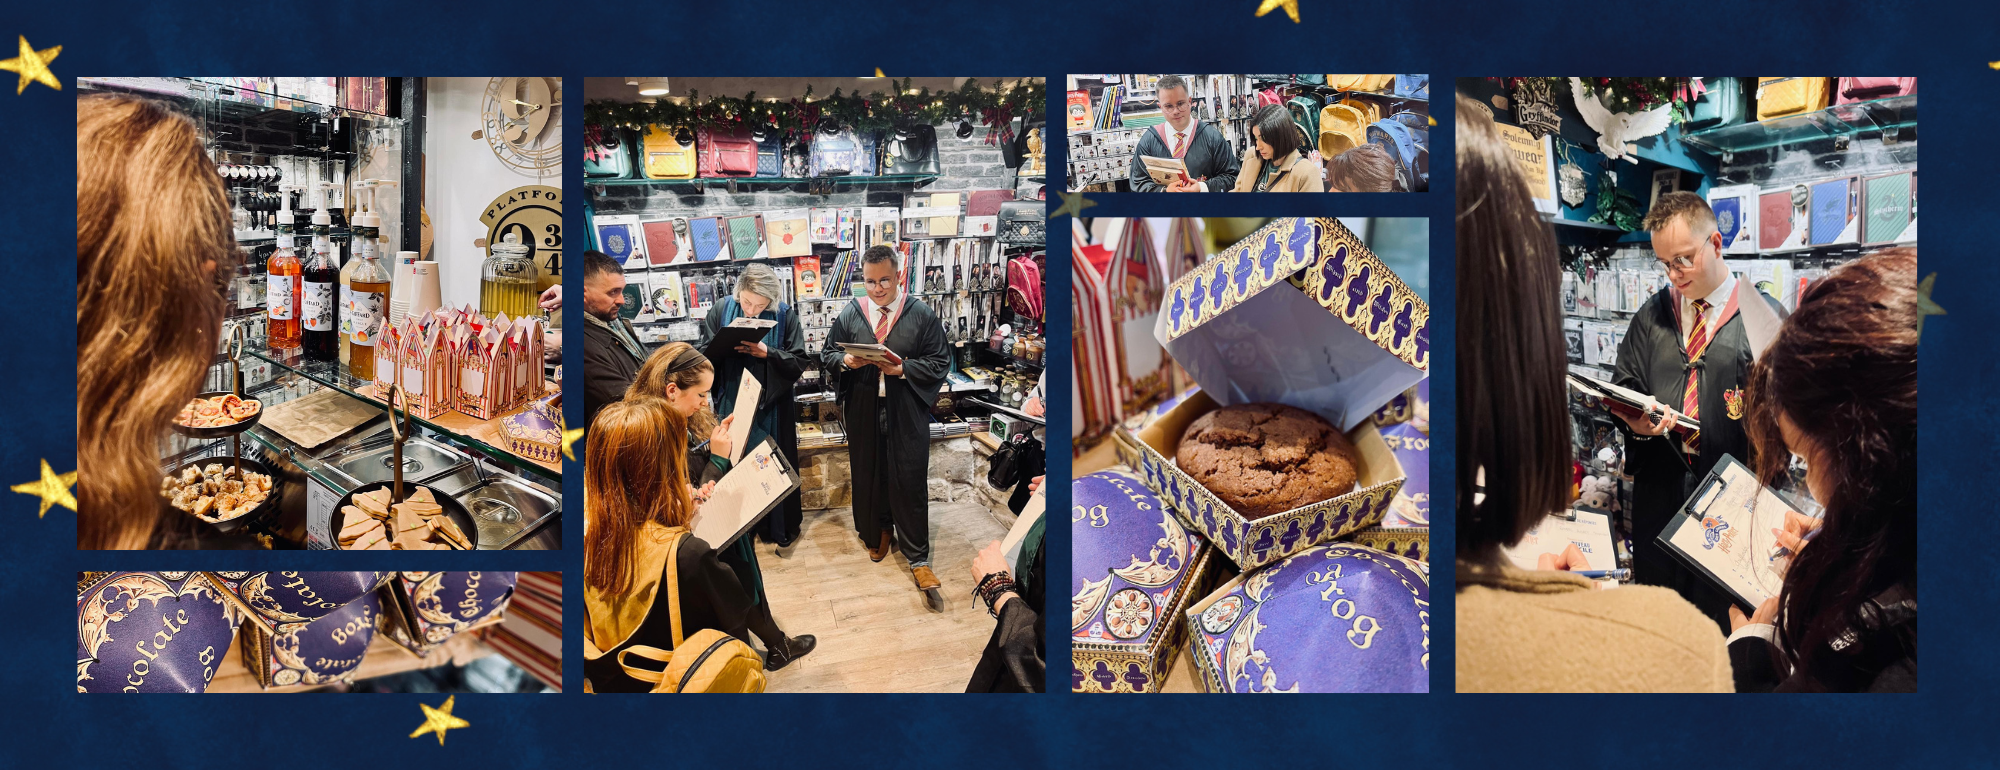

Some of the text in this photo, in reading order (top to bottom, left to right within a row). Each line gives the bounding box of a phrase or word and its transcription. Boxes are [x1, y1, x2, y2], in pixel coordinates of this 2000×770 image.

[1520, 105, 1559, 127] Gryffindor
[1511, 148, 1544, 164] wear
[487, 190, 562, 219] PLATFO
[544, 223, 562, 248] 3
[544, 252, 562, 276] 4
[1384, 434, 1429, 451] Fro
[199, 645, 215, 691] og
